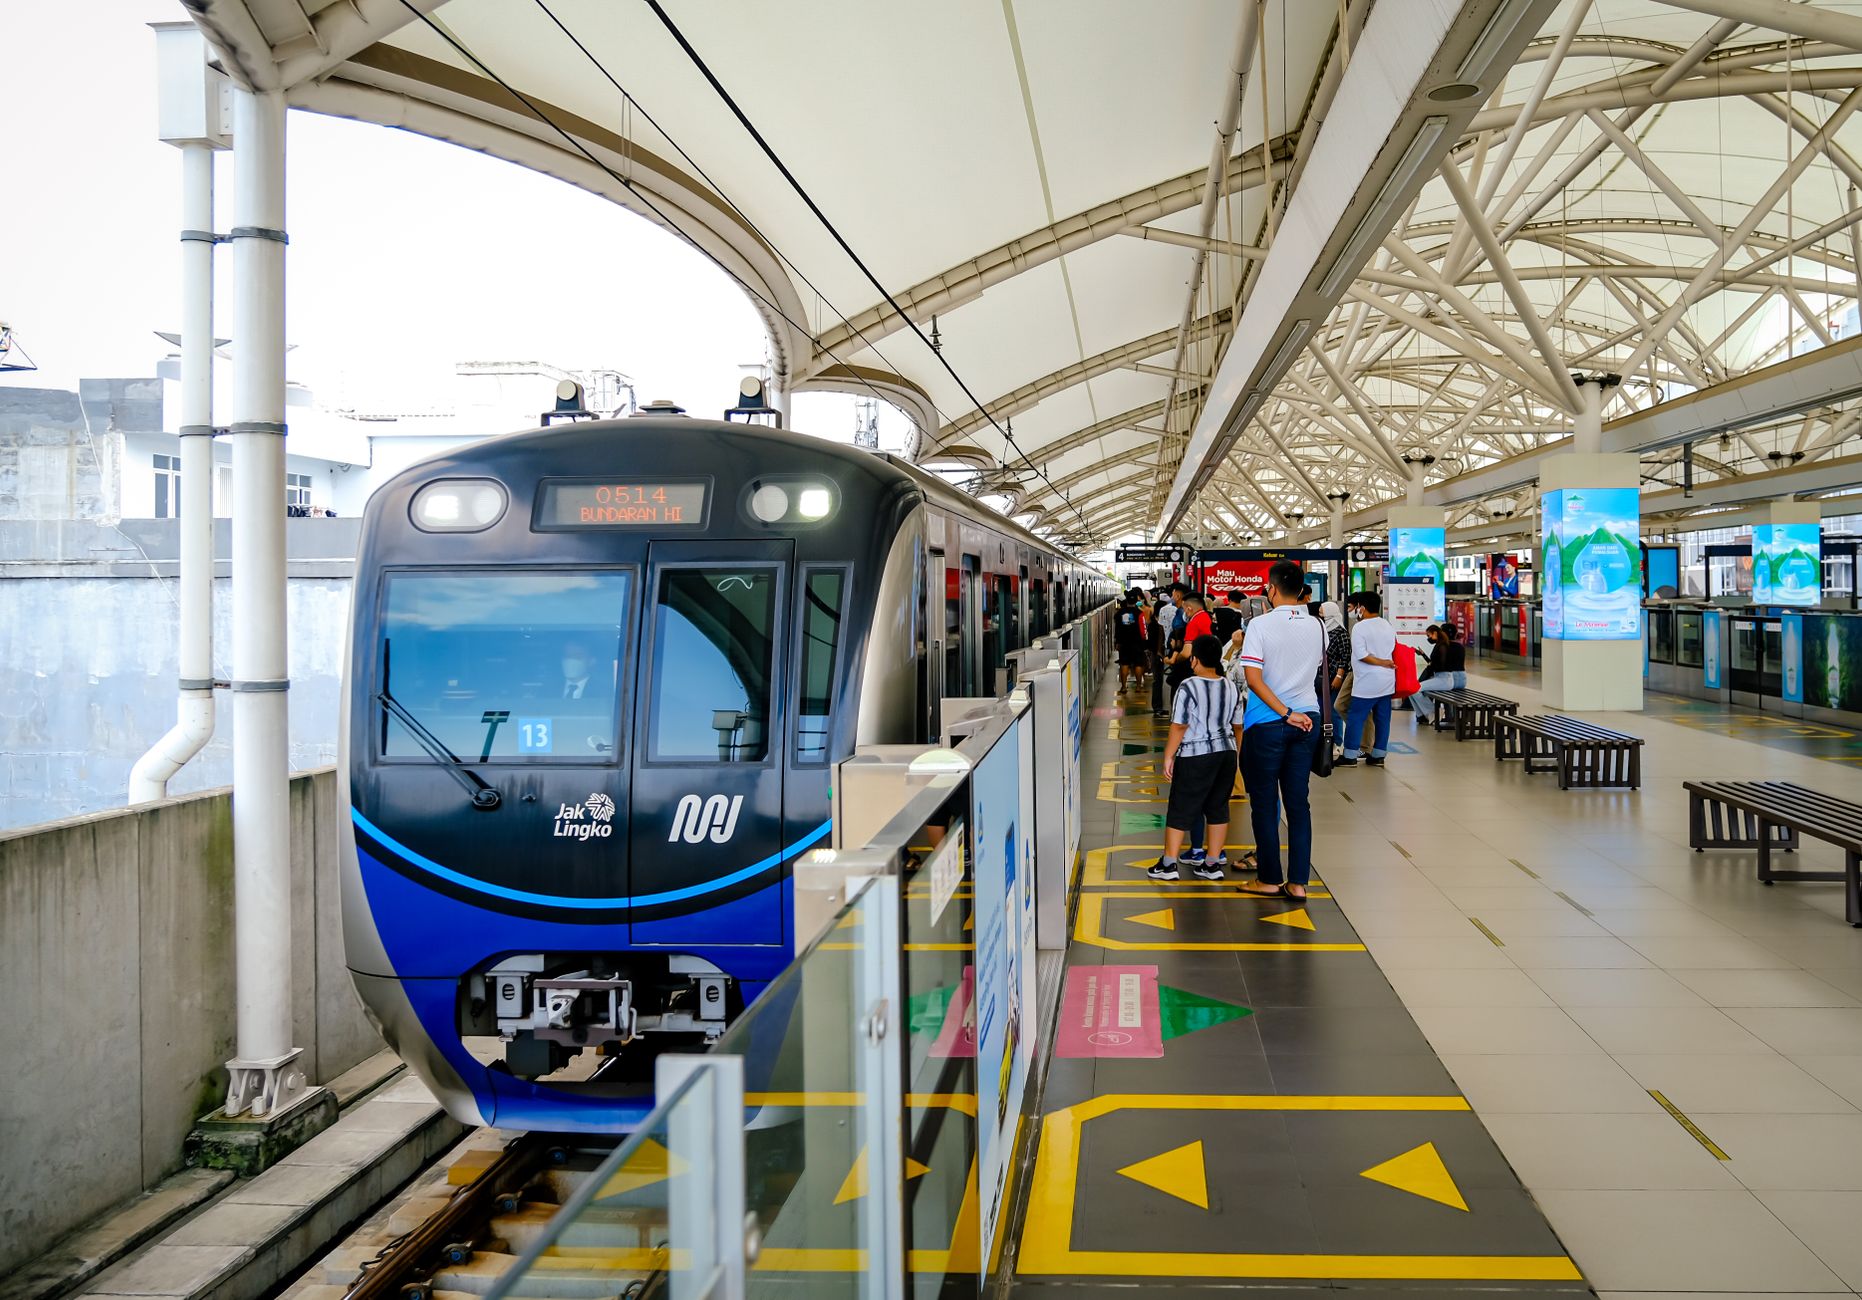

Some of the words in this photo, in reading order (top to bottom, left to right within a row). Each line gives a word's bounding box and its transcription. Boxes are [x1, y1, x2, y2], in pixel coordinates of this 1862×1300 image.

[595, 486, 667, 504] 0514
[580, 506, 656, 522] BUNDARAN
[664, 506, 683, 522] HI
[1118, 552, 1125, 561] 4
[1234, 575, 1263, 583] Honda
[522, 724, 548, 748] 13
[554, 803, 585, 820] Jak
[554, 820, 612, 841] Lingko
